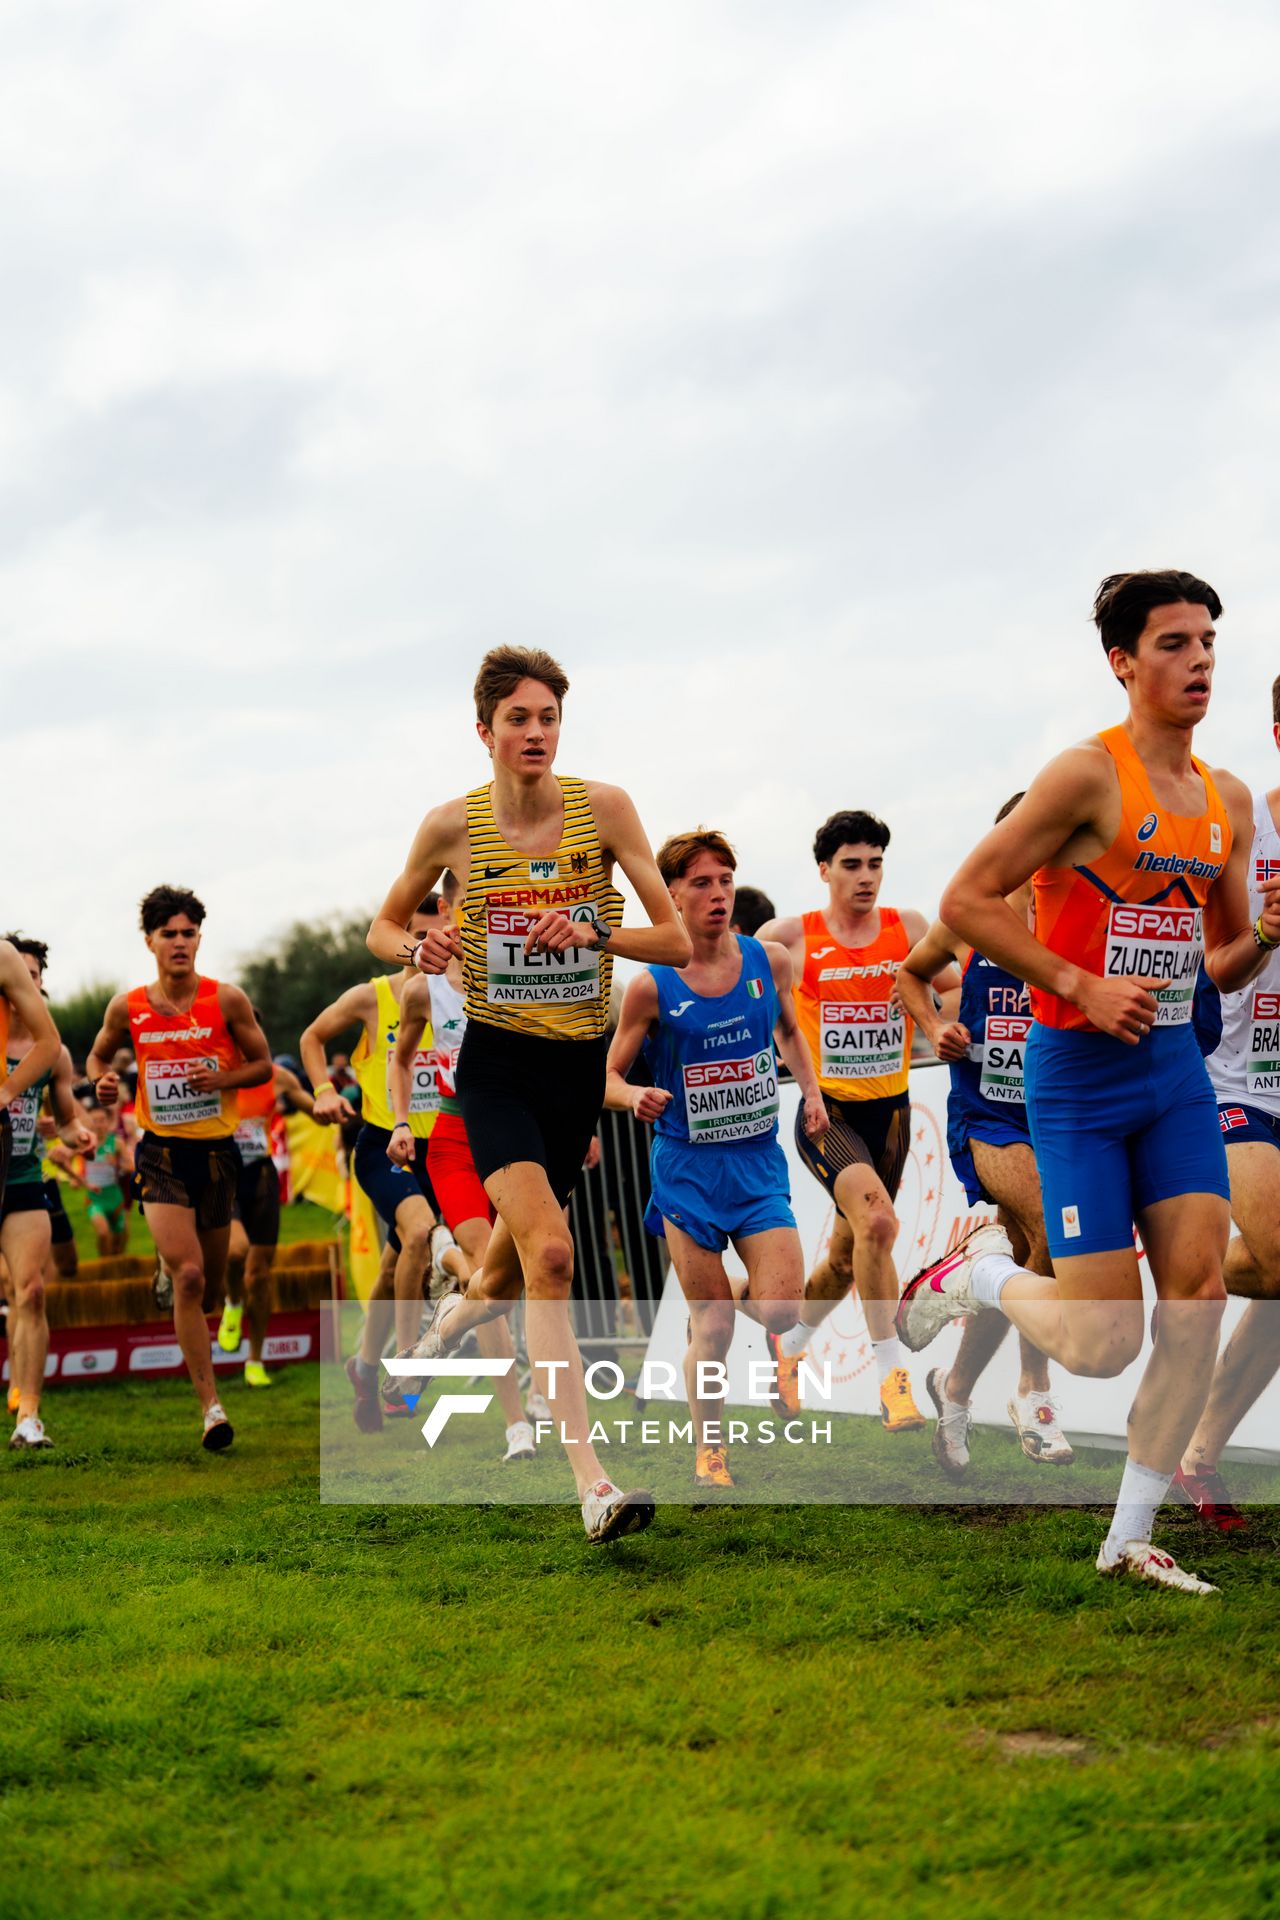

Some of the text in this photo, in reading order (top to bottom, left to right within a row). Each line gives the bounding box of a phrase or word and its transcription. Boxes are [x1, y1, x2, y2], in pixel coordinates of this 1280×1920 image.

[485, 883, 592, 908] GERMANY
[490, 913, 569, 932] SP
[1114, 910, 1195, 937] SPAR
[515, 974, 540, 984] RUN
[494, 983, 594, 1000] ANTALYA 2024
[988, 987, 1033, 1013] FRA
[824, 1006, 887, 1022] SPAR
[139, 1026, 212, 1044] ESPAÑA
[825, 1026, 903, 1050] GAITAN
[989, 1021, 1032, 1038] SP
[1252, 1022, 1280, 1053] BRÅ
[703, 1028, 752, 1050] ITALIA
[844, 1055, 862, 1063] RUN
[987, 1047, 1024, 1070] SA
[687, 1061, 754, 1085] SPAR
[827, 1061, 900, 1076] ANTALYA 2024
[689, 1077, 776, 1114] SANTANGELO
[986, 1086, 1026, 1100] ANTAL
[155, 1110, 195, 1122] ANTALYA
[714, 1117, 733, 1127] RUN
[696, 1124, 751, 1142] ANTALYA
